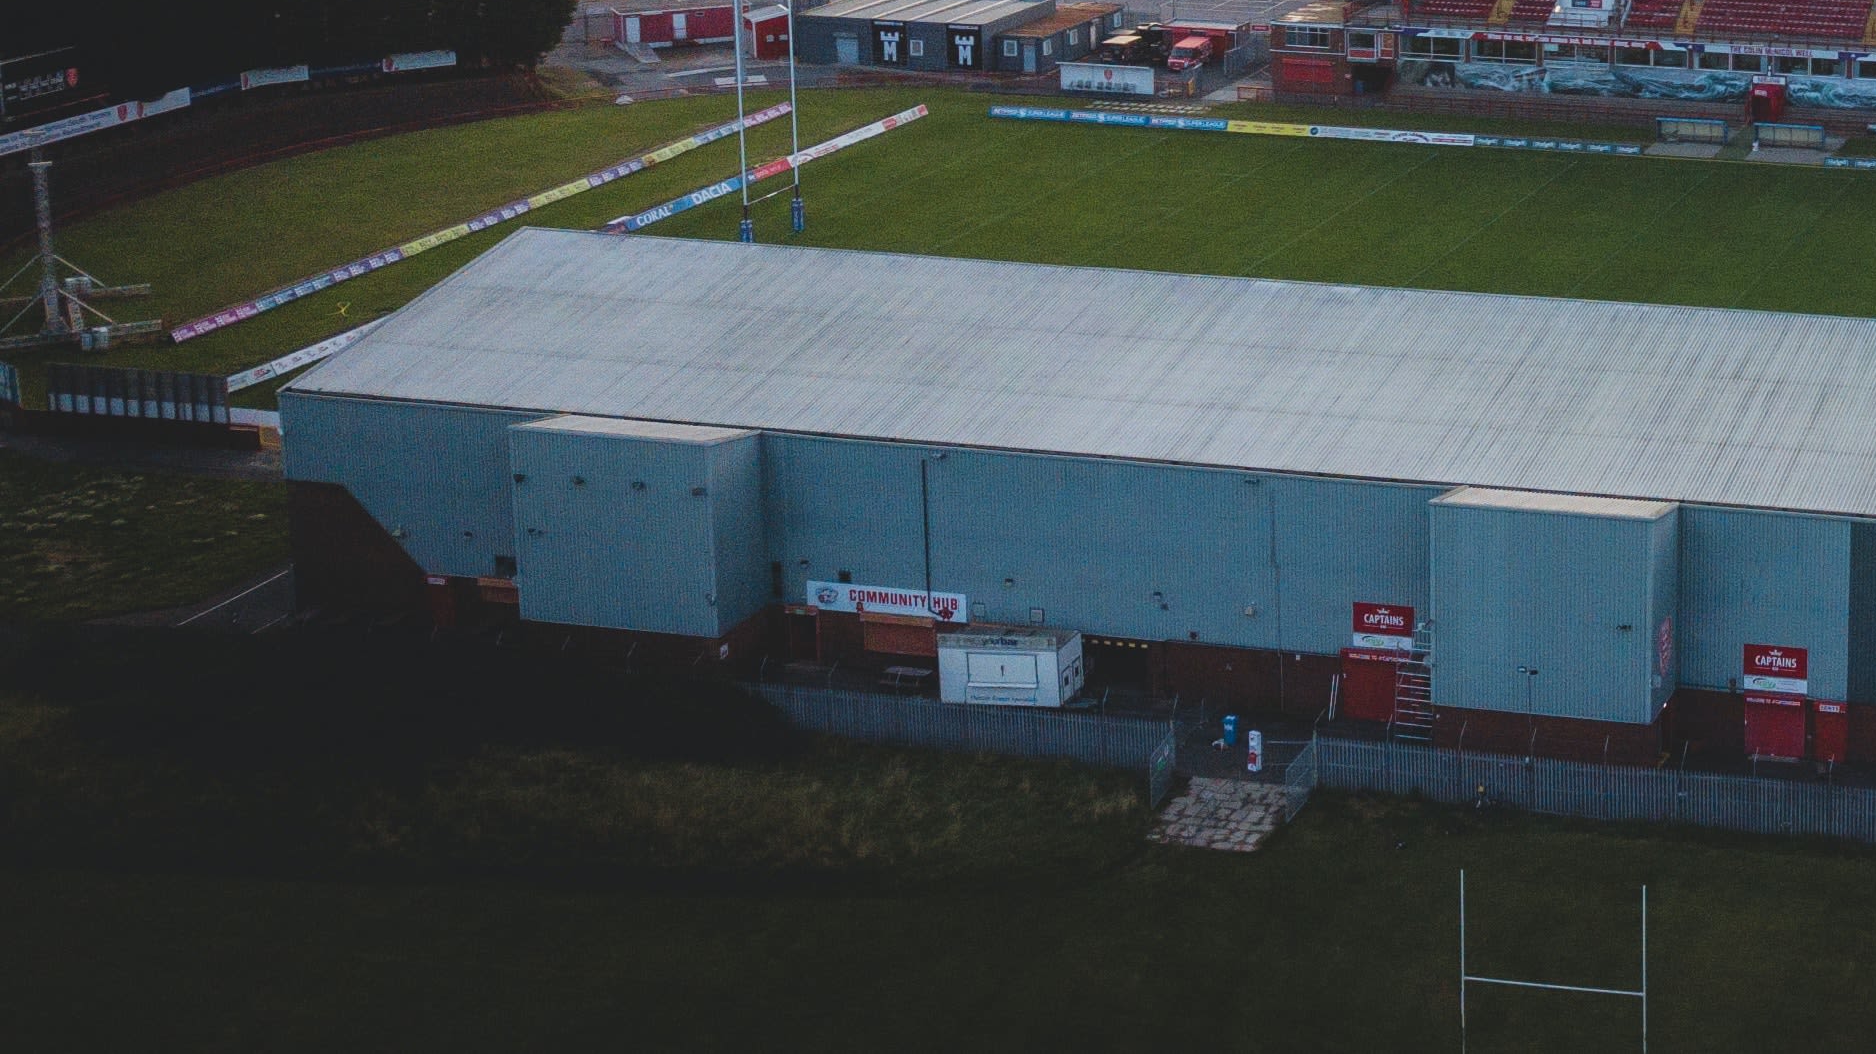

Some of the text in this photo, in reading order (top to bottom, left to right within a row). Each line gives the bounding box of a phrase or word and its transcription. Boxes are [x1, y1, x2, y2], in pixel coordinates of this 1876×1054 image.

[692, 181, 732, 205] DACIA
[635, 205, 672, 228] CORAL
[849, 588, 959, 611] COMMUNITY HUB
[1363, 613, 1405, 626] CAPTAINS
[1754, 655, 1797, 669] CAPTAINS
